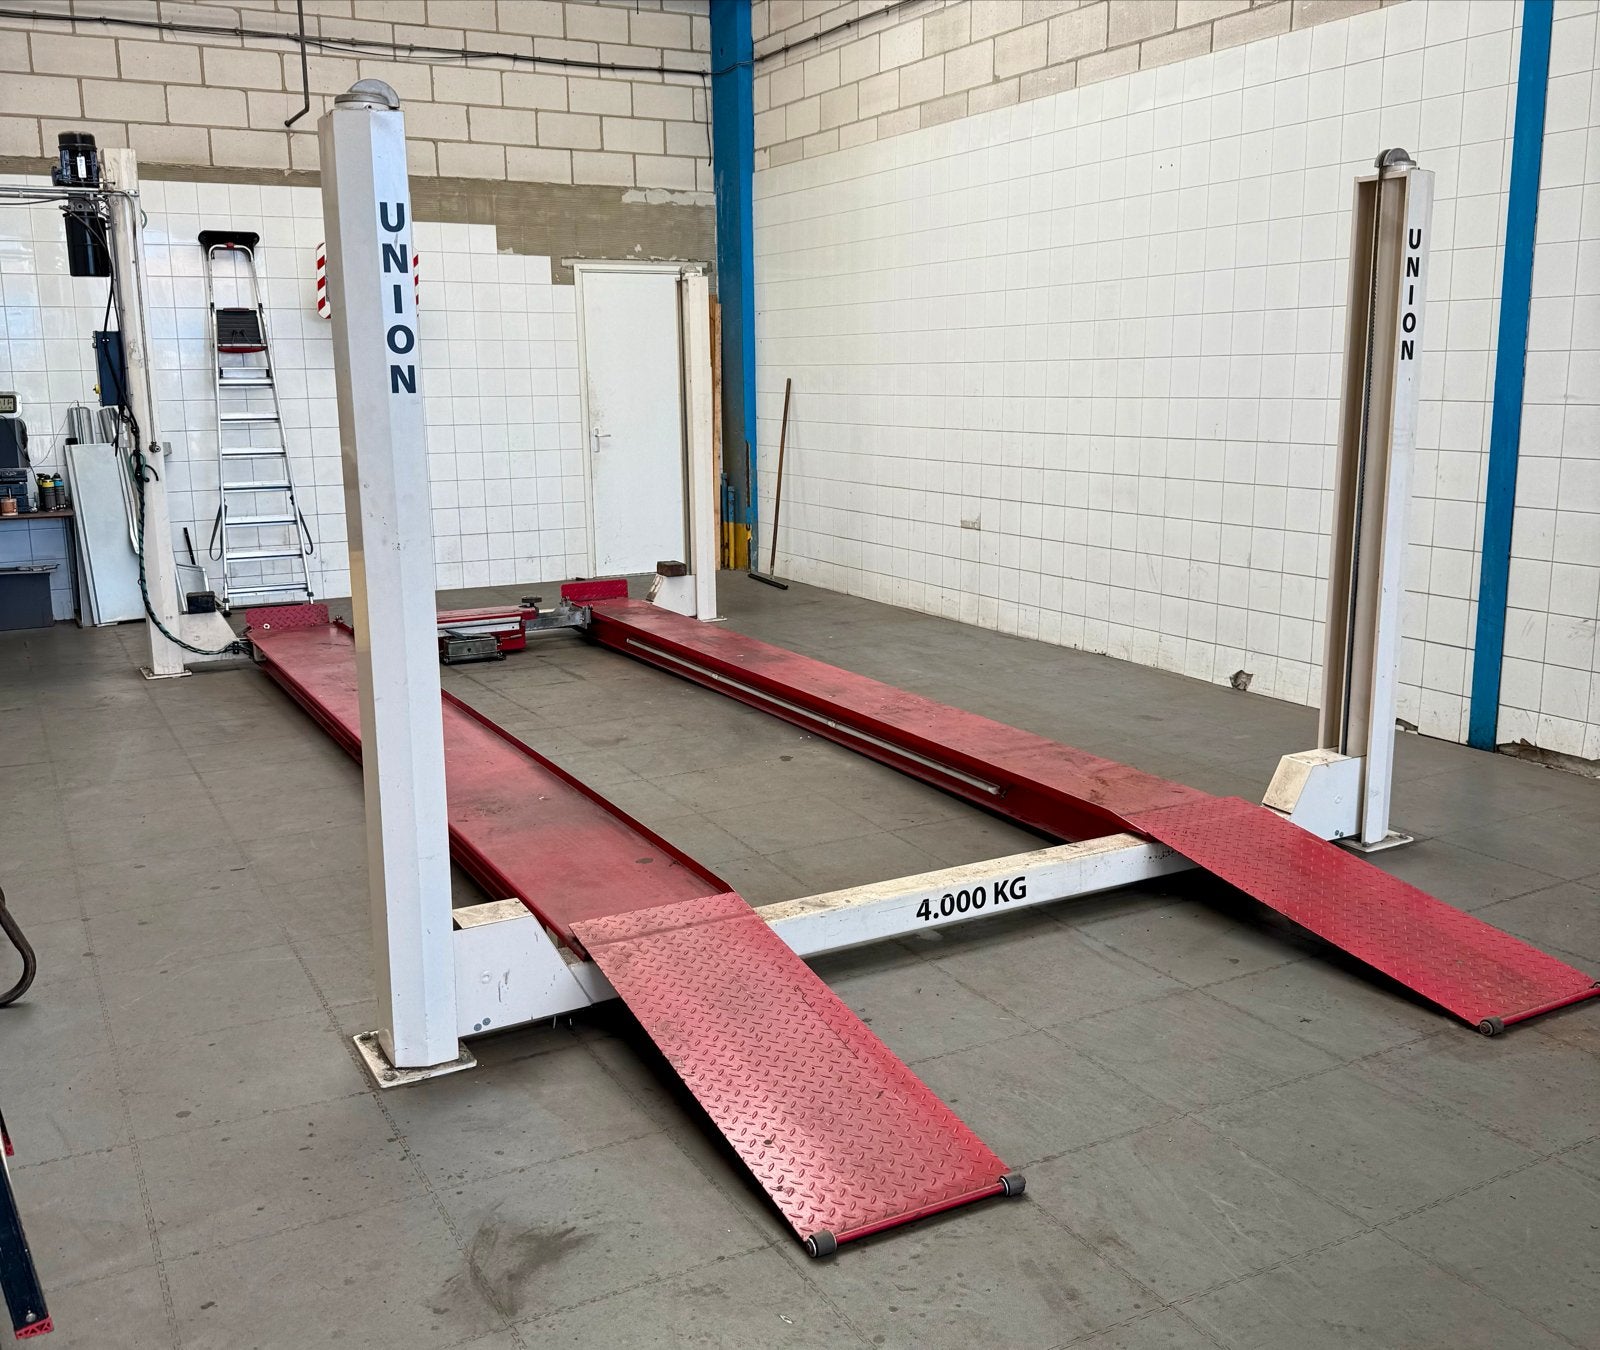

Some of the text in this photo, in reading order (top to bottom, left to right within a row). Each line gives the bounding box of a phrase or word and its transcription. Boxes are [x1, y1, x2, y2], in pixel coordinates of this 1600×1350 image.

[379, 202, 417, 394] UNION
[1401, 228, 1421, 361] UNION
[916, 876, 1027, 921] 4.000 KG
